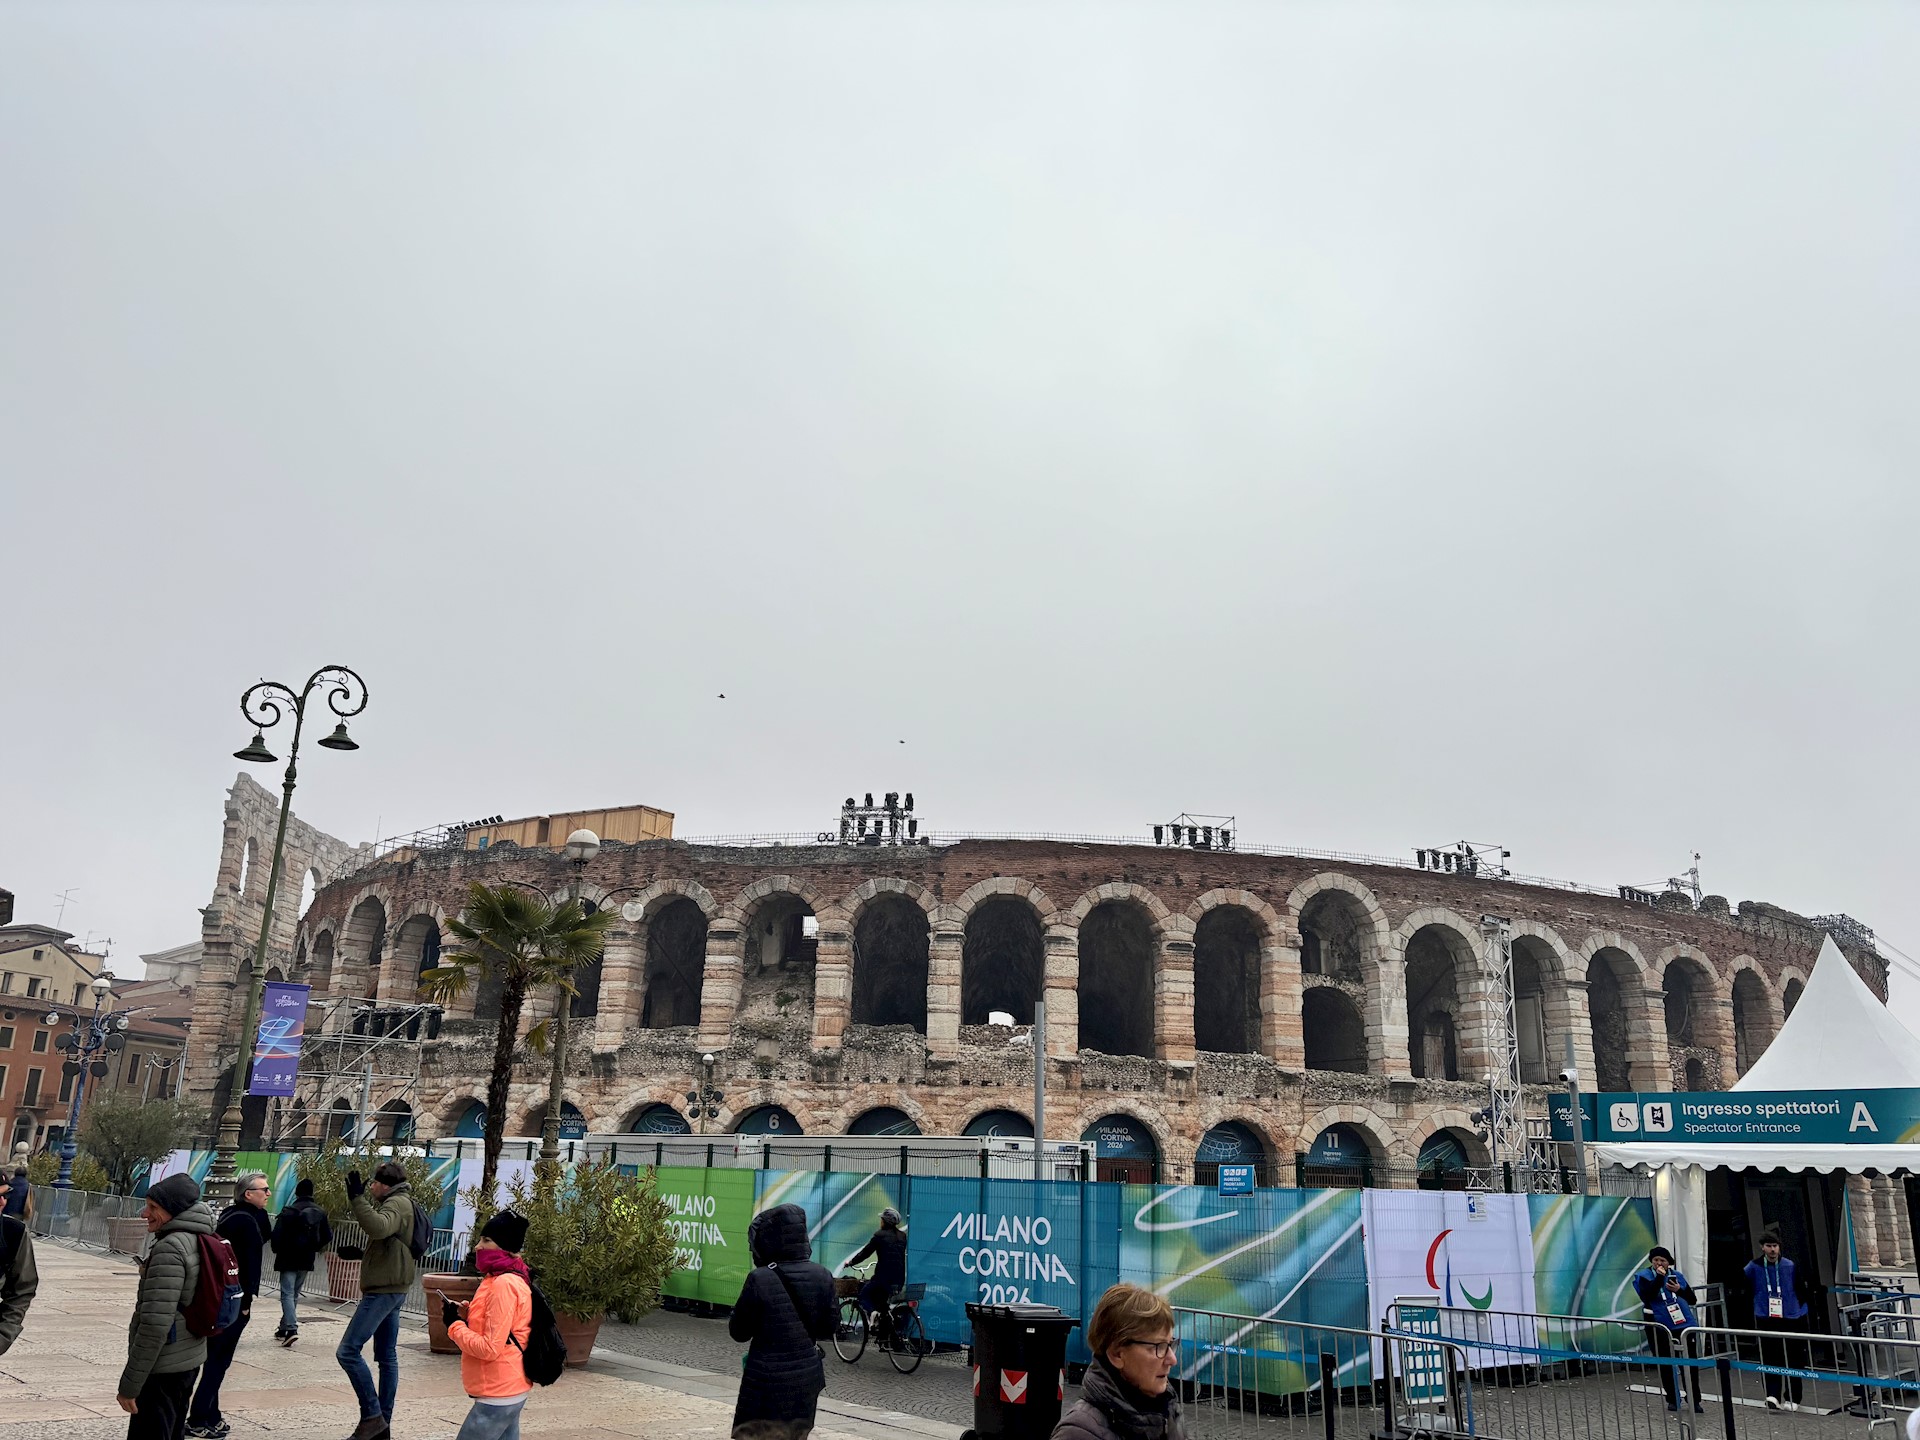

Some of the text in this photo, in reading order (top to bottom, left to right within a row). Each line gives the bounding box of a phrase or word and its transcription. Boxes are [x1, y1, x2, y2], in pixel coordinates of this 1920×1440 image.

[1683, 1100, 1840, 1118] Ingresso spettatori
[1849, 1102, 1879, 1132] A
[769, 1114, 779, 1129] 6
[1684, 1122, 1801, 1135] Spectator Entrance
[1101, 1134, 1136, 1142] CORTINA
[1326, 1133, 1339, 1148] 11
[659, 1193, 716, 1217] MILANO
[941, 1212, 1052, 1246] MILANO
[959, 1247, 1076, 1285] CORTINA
[1781, 1369, 1806, 1377] CORTINA
